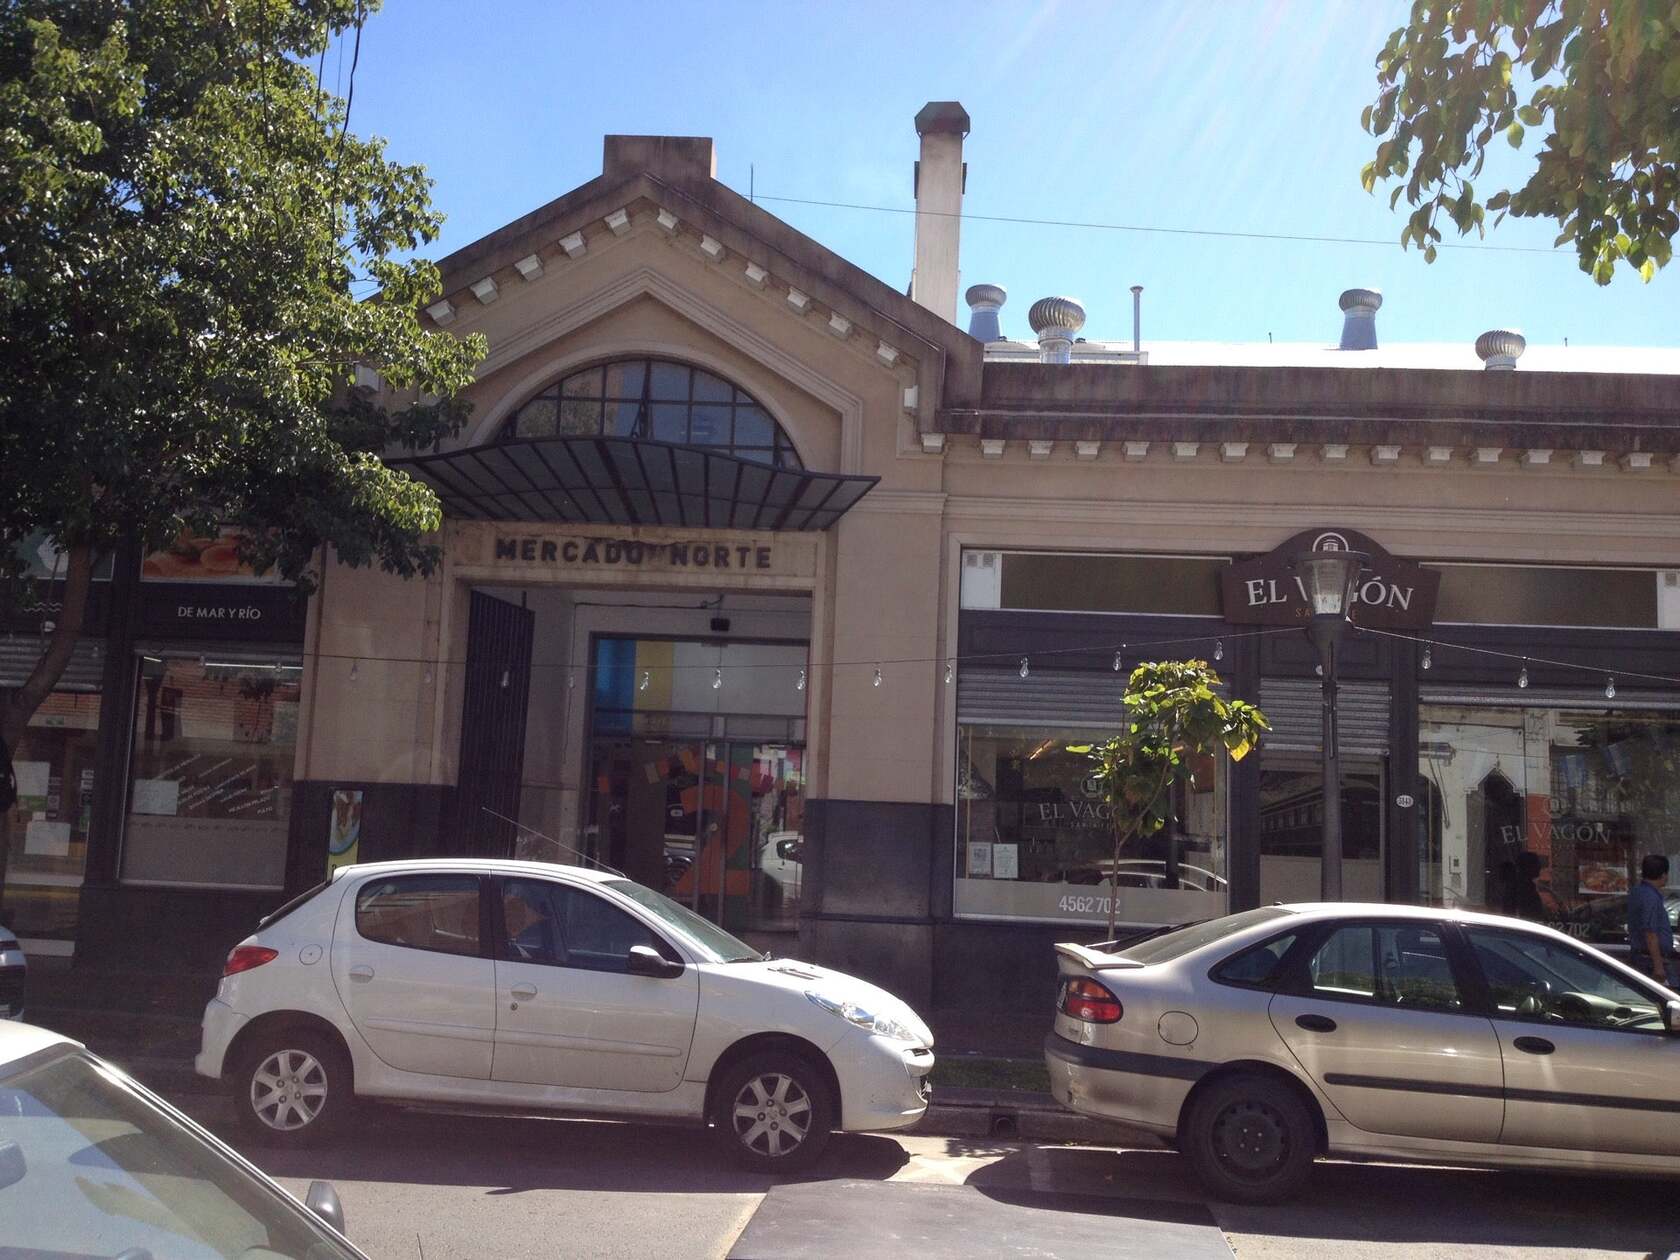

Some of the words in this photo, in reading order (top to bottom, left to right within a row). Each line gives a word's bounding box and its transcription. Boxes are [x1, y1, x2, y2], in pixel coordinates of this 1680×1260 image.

[495, 538, 643, 565] MERCADO
[670, 544, 772, 569] NORTE
[1245, 579, 1287, 606] EL
[178, 606, 194, 618] DE
[196, 607, 225, 619] MAR
[228, 608, 237, 619] Y
[238, 605, 262, 620] RÍO
[1040, 802, 1064, 820] EL
[1501, 825, 1528, 844] EL
